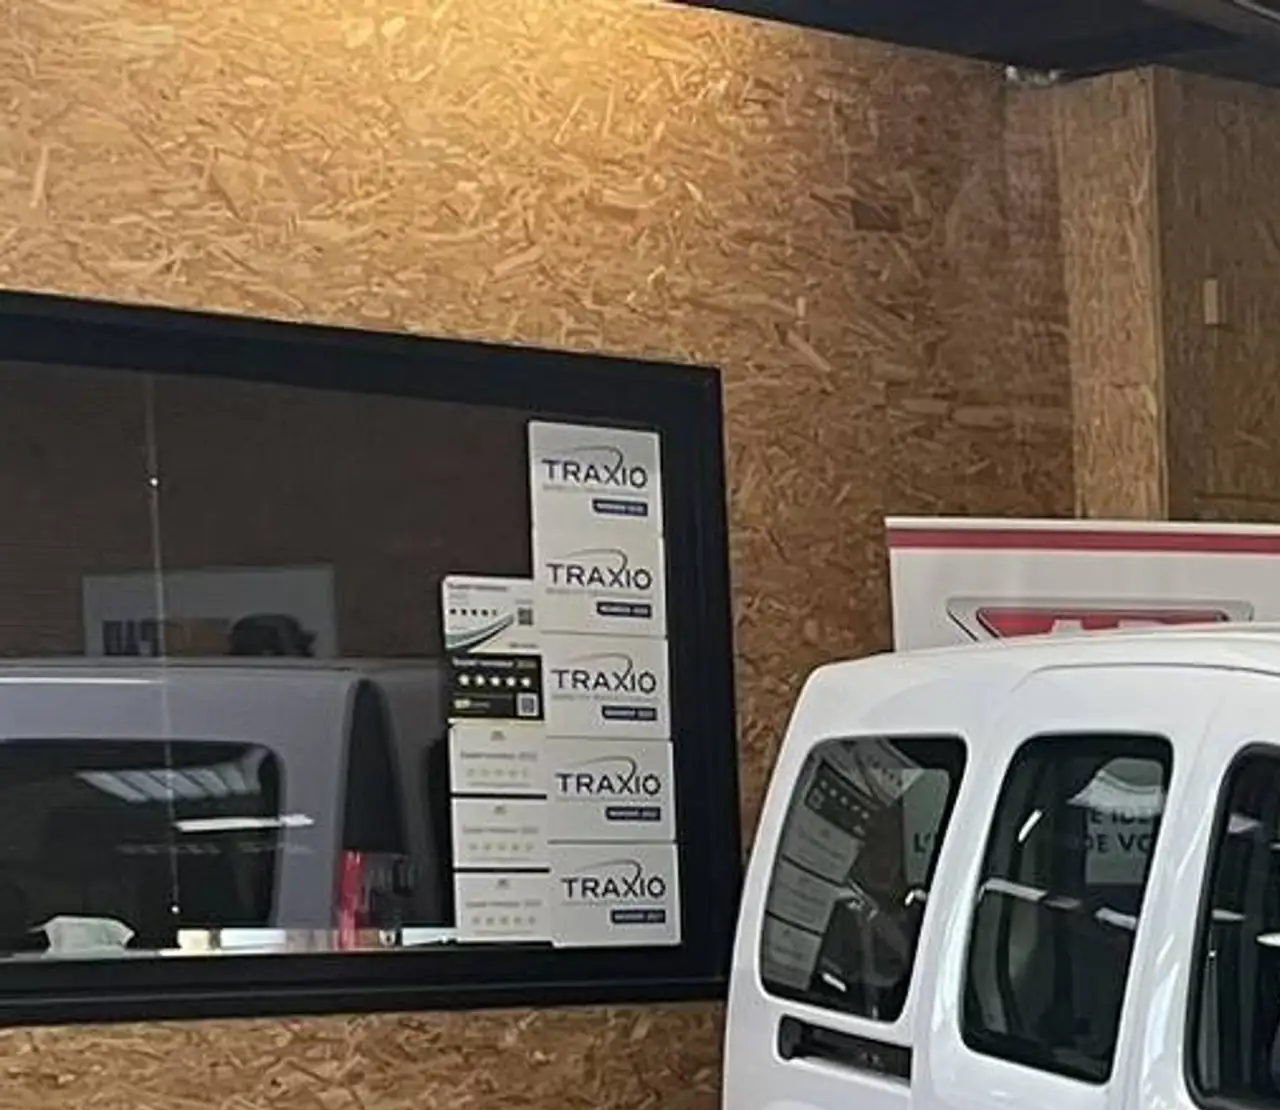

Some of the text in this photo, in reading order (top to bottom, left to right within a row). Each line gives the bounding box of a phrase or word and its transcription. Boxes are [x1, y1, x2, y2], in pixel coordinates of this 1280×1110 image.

[541, 458, 648, 489] TRAXIO
[546, 562, 653, 590] TRAXIO
[551, 669, 658, 695] TRAXIO
[555, 772, 662, 796] TRAXIO
[560, 876, 666, 899] TRAXIO
